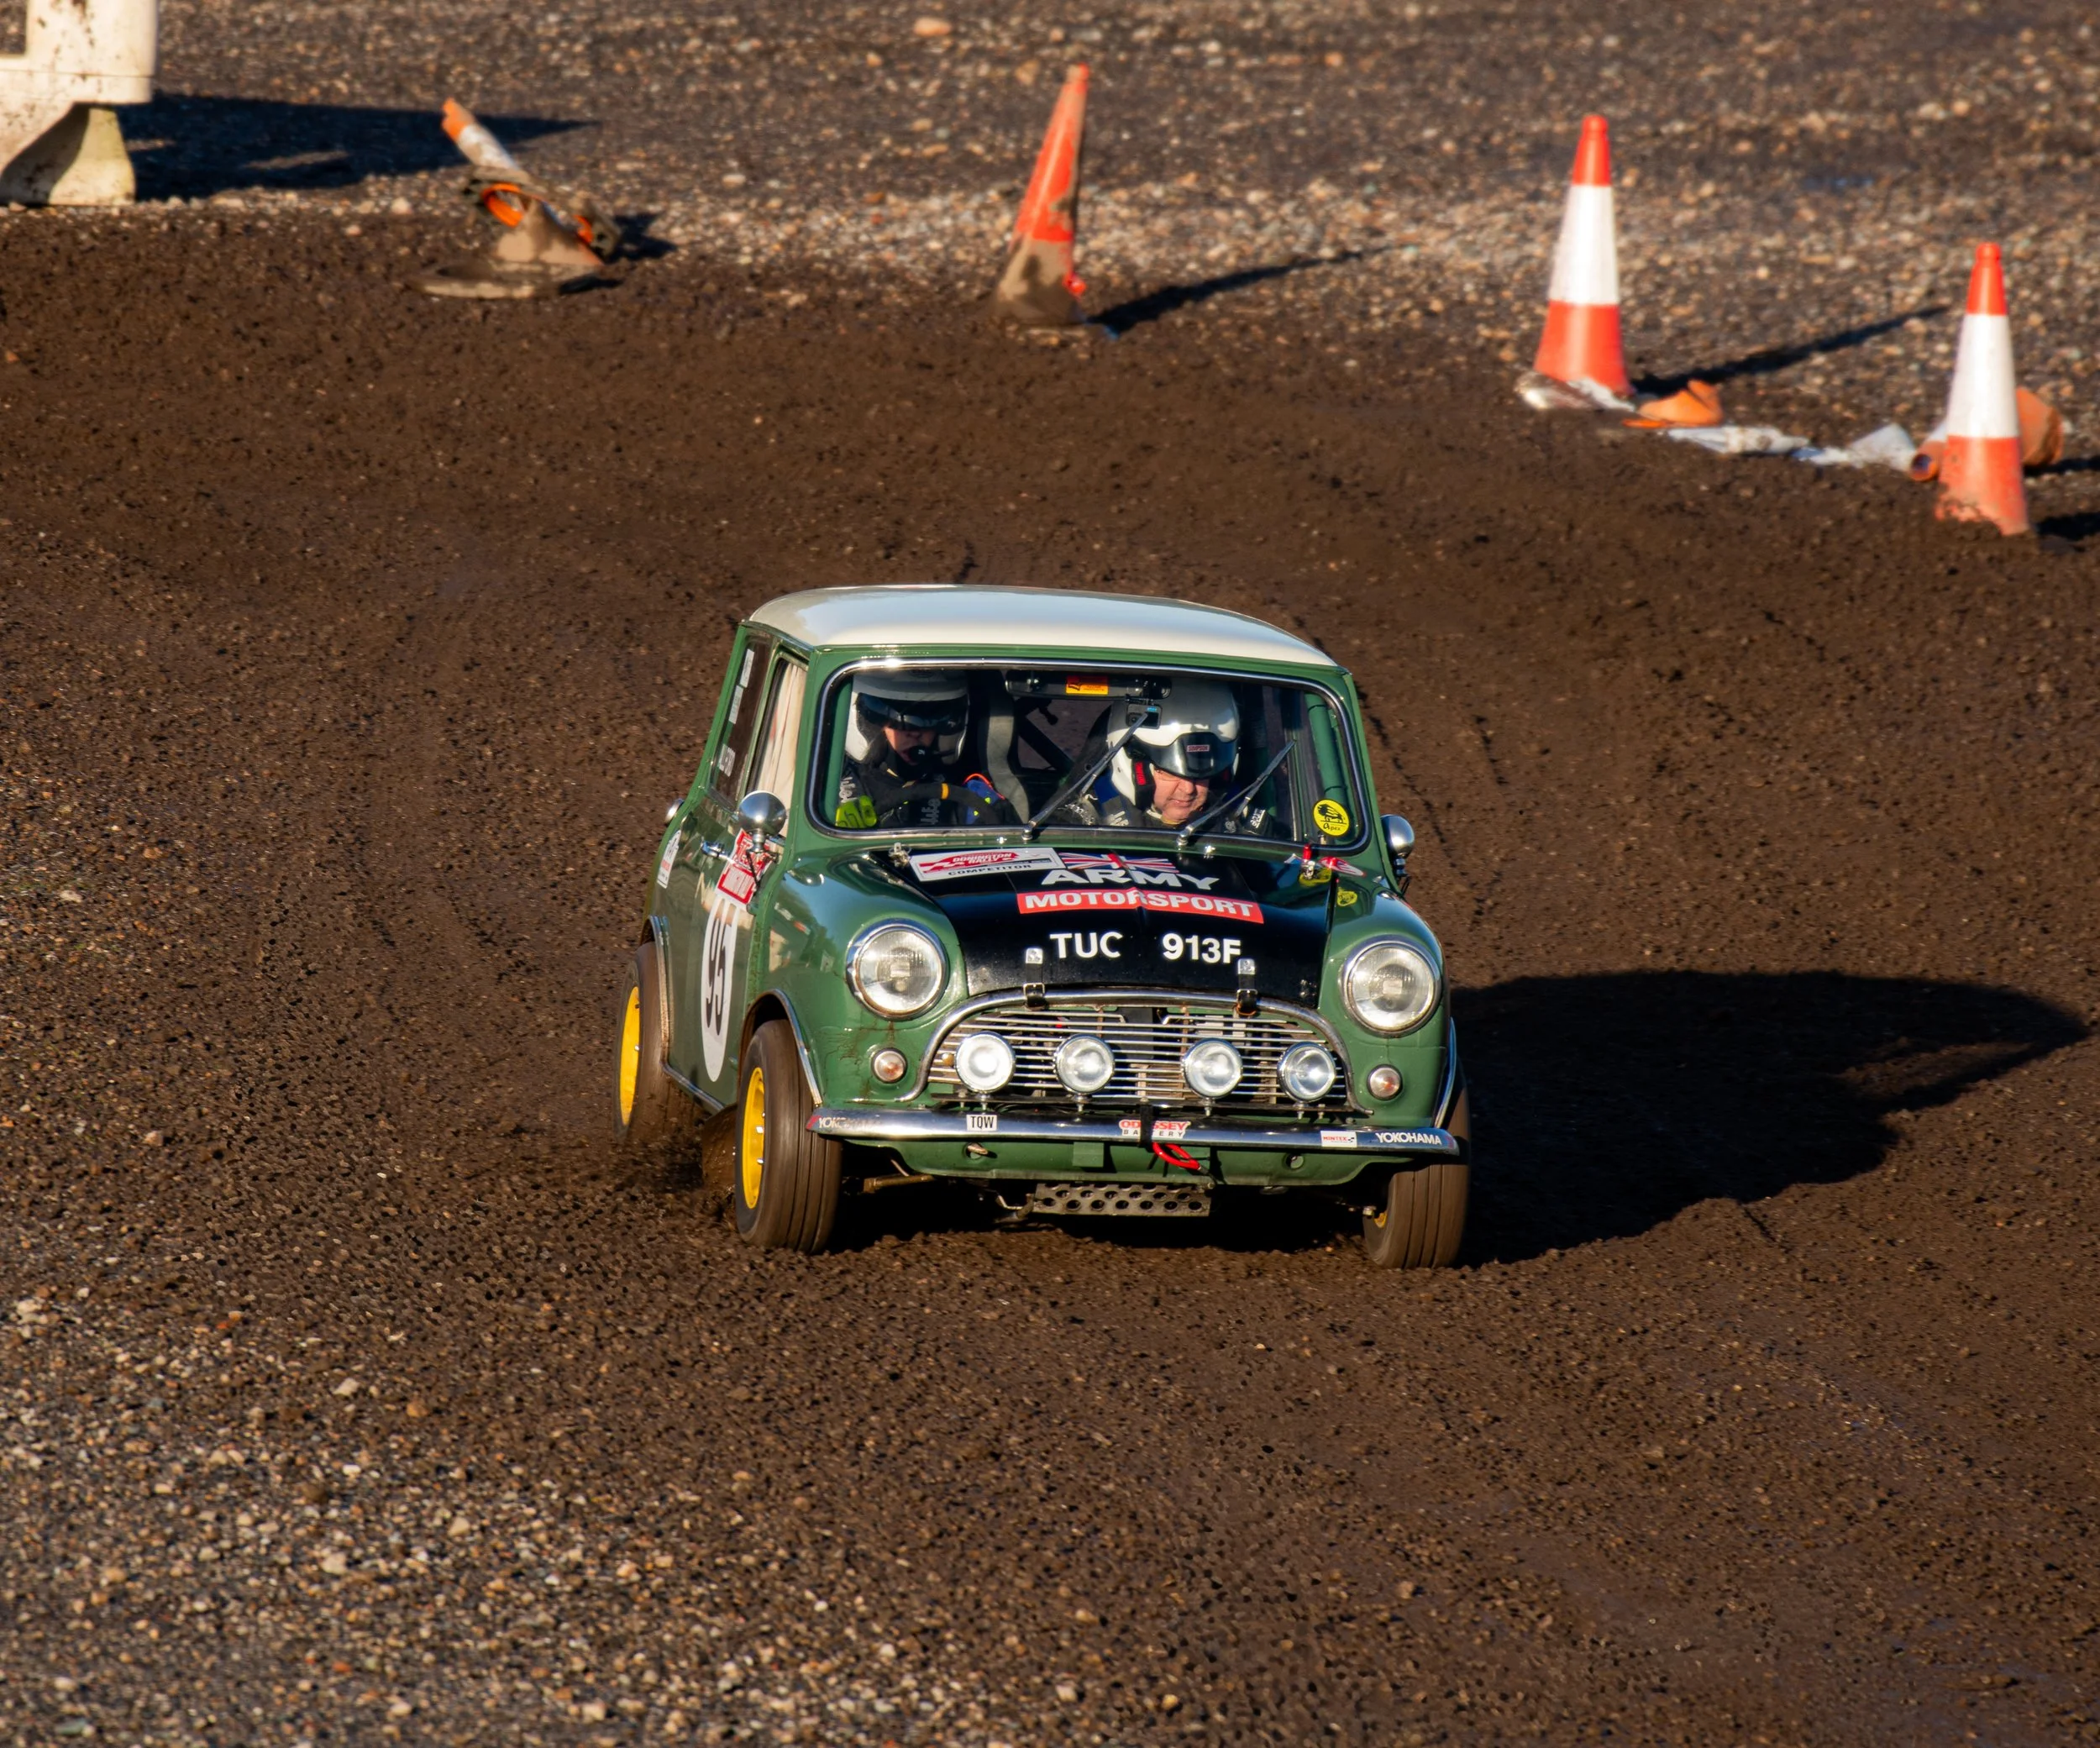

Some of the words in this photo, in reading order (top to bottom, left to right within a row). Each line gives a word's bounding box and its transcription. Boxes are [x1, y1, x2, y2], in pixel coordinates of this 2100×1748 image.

[953, 853, 1012, 863] DONINGTON
[968, 856, 999, 864] RALLY
[948, 864, 1032, 875] COMPETITOR
[1041, 869, 1220, 890] ARMY
[1025, 890, 1253, 916] MOTORSPORT
[1049, 932, 1123, 958] TUC
[1162, 932, 1242, 964] 913F
[706, 899, 738, 1036] 95
[1121, 1120, 1188, 1130] ODSSEY
[1375, 1132, 1442, 1145] YOKOHAMA
